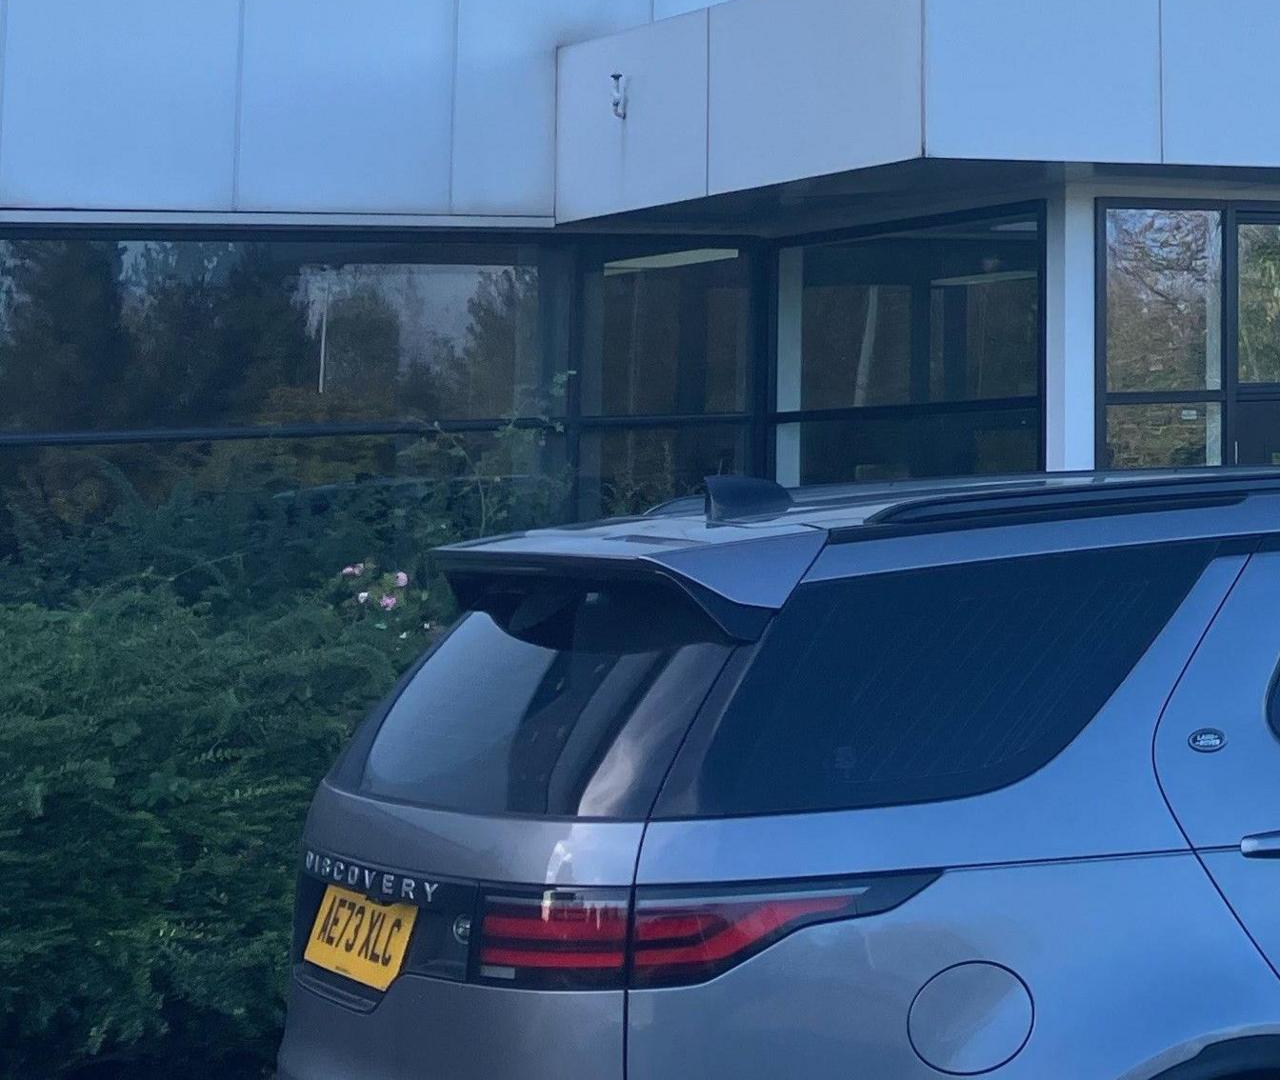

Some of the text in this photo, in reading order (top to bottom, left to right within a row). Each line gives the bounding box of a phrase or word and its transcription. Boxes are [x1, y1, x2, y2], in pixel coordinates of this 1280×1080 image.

[306, 851, 438, 903] DISCOVERY
[317, 895, 402, 967] AE73 XLC
